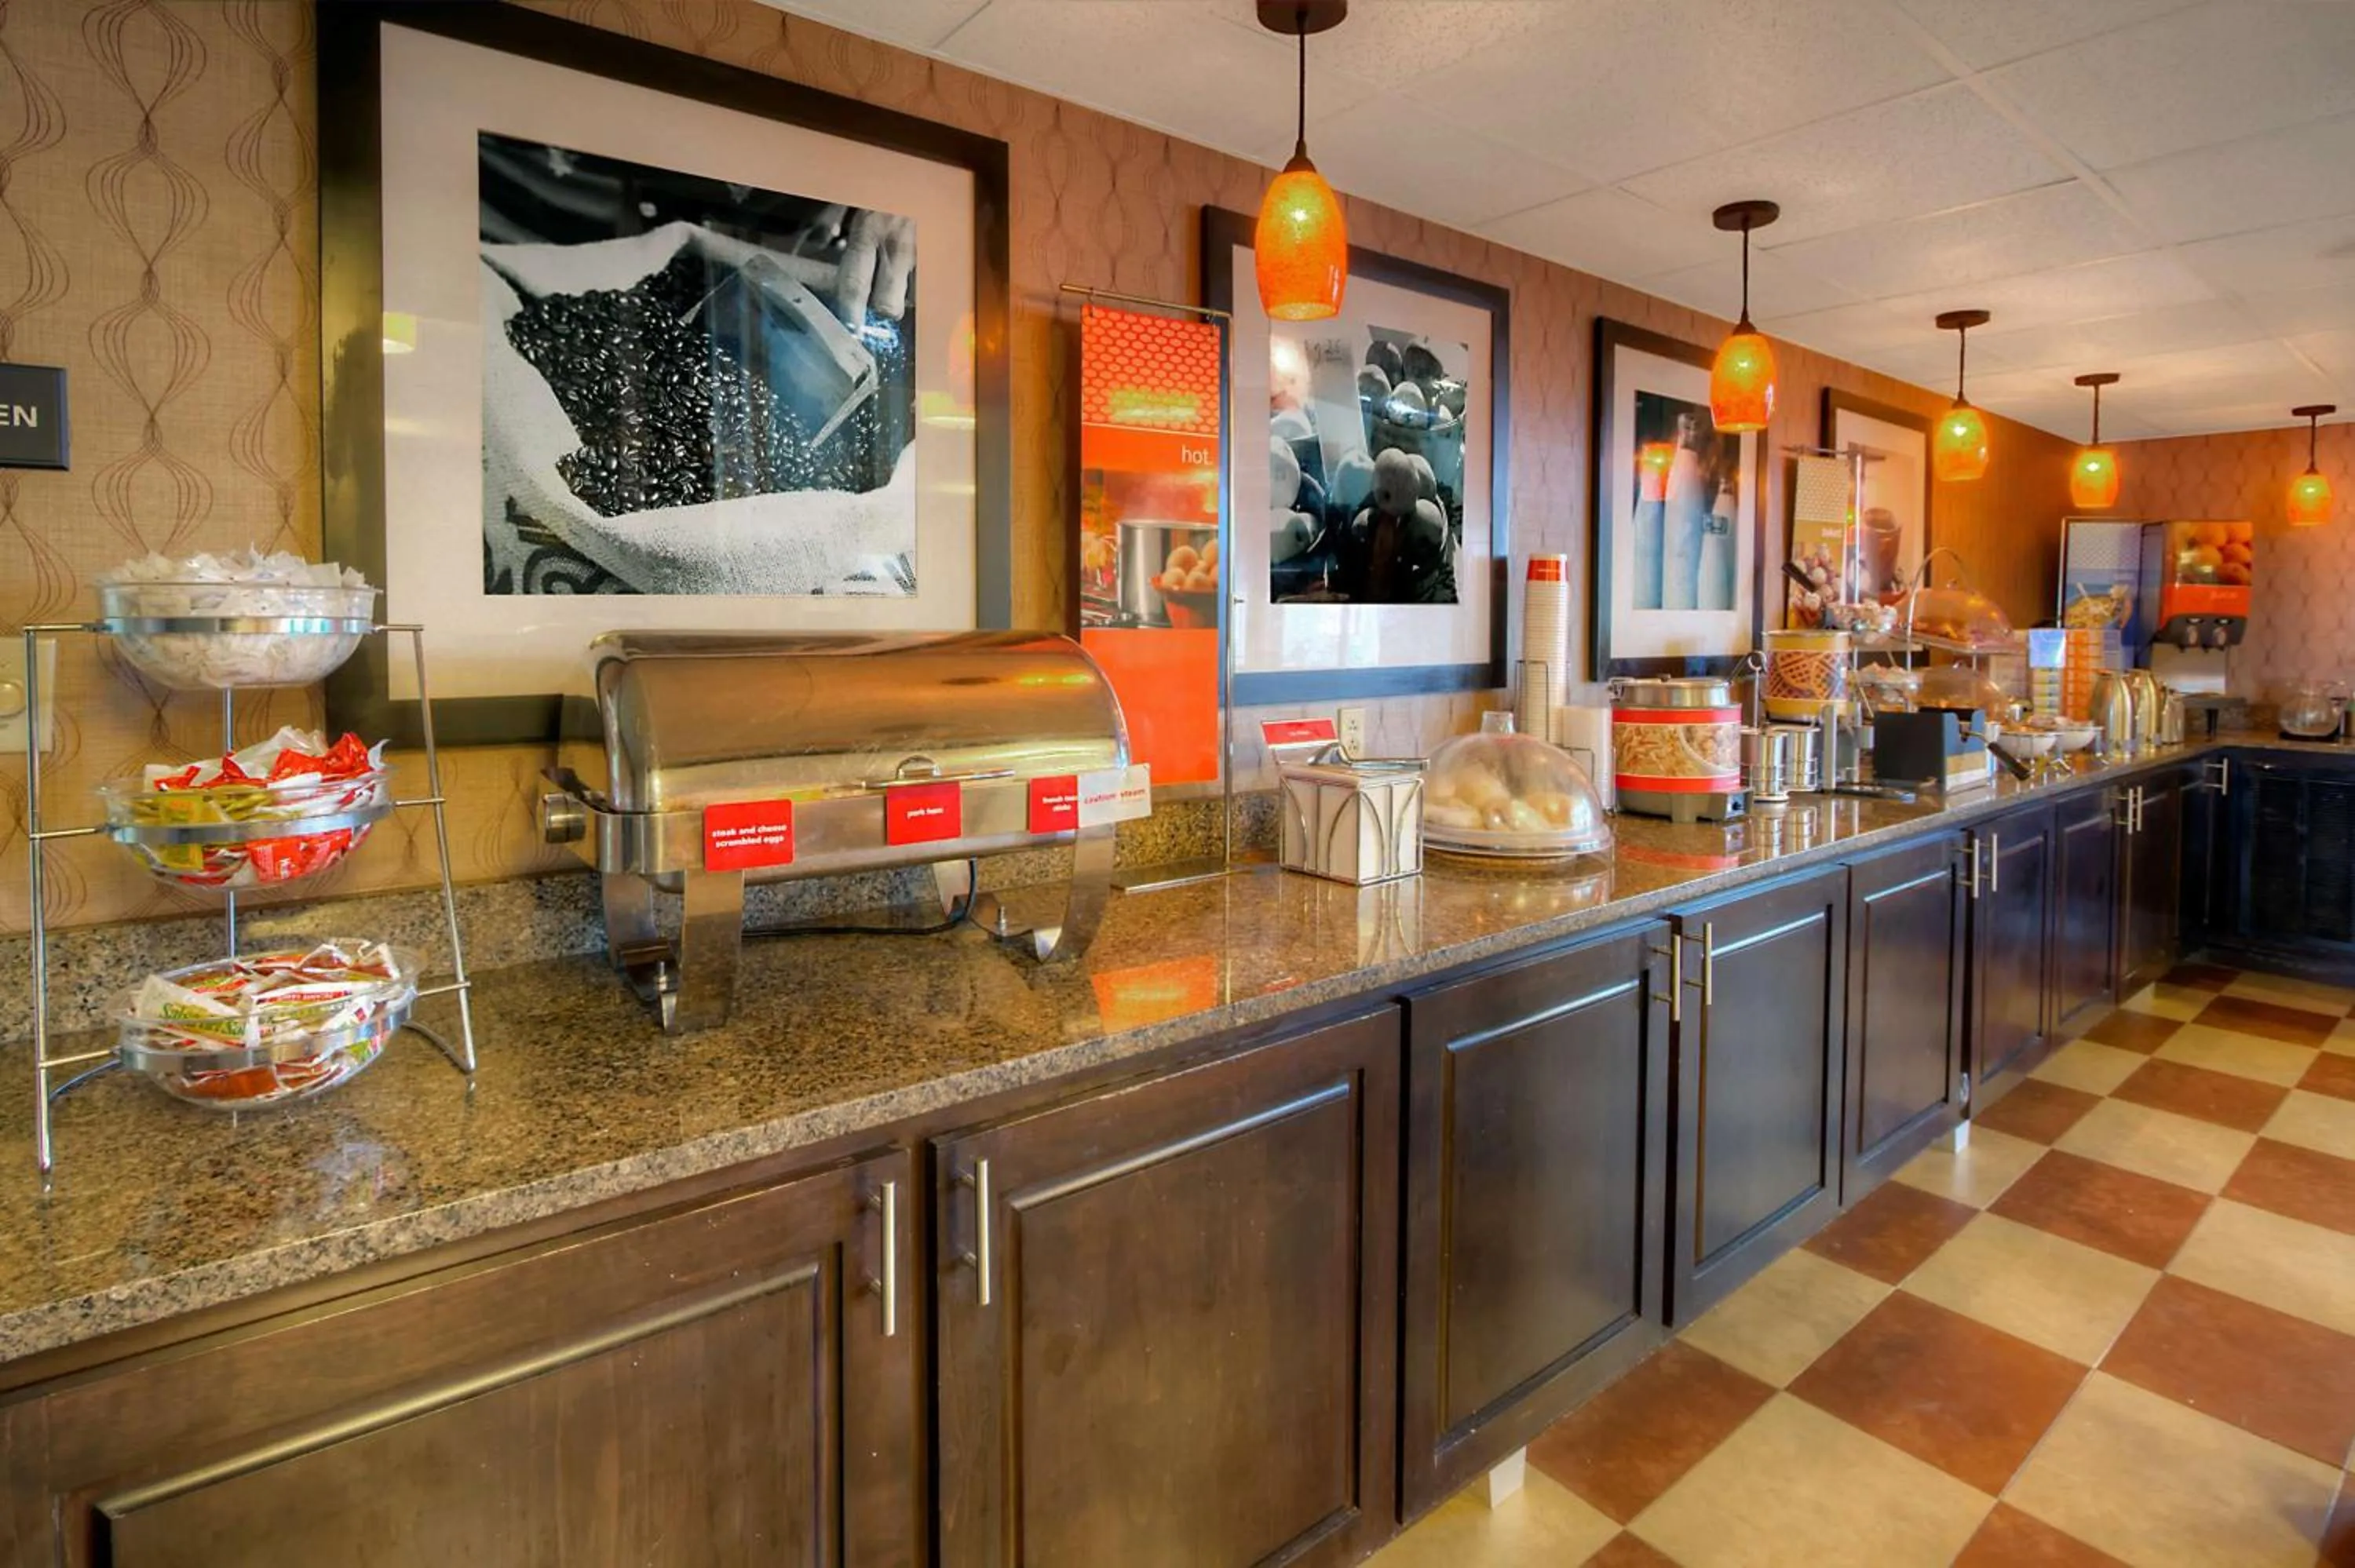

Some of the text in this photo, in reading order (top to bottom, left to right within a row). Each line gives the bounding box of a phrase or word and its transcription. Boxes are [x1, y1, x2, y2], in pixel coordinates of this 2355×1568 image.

[739, 826, 756, 834] and
[758, 824, 787, 833] cheese
[715, 835, 786, 848] scrambled eggs
